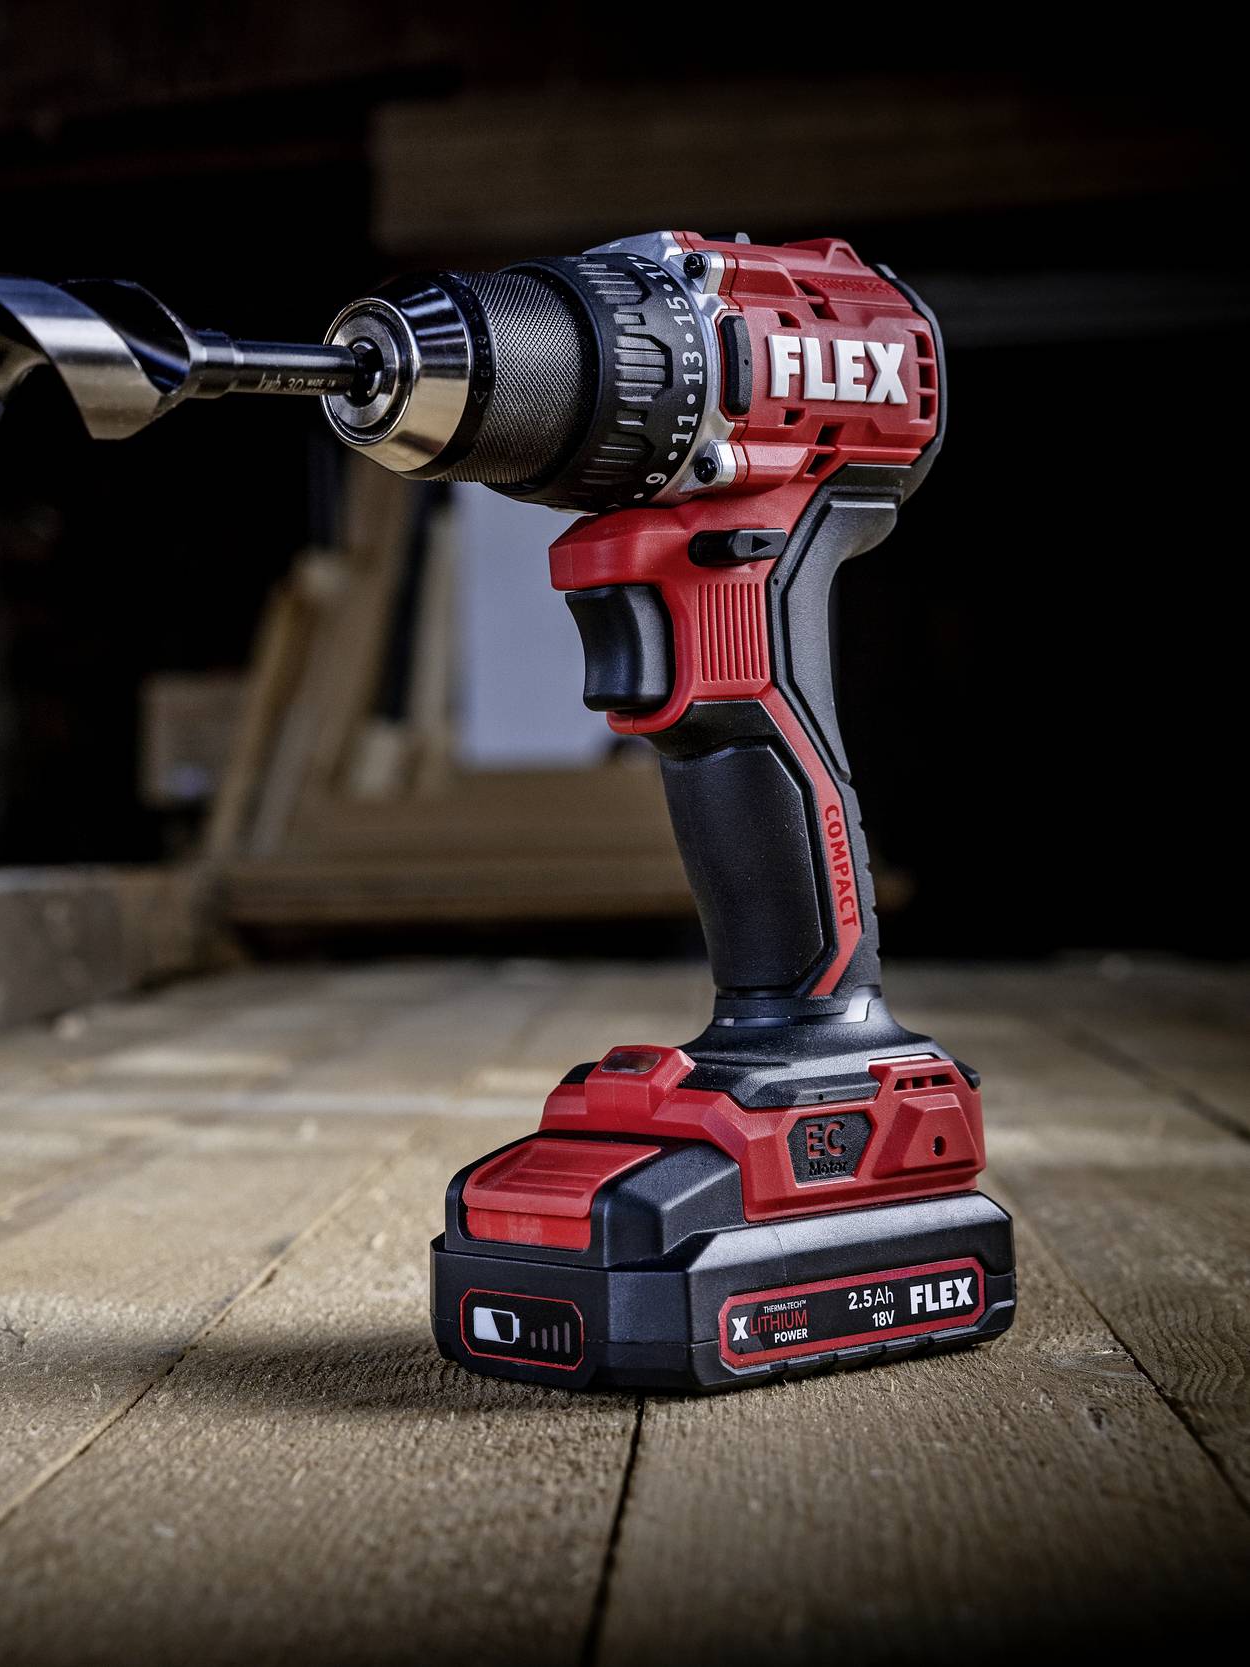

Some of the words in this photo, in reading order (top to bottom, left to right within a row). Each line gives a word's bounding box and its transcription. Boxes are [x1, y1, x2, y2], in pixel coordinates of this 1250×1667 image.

[665, 296, 696, 326] 15
[682, 351, 703, 385] 13
[766, 334, 908, 405] FLEX
[671, 412, 699, 445] 11
[825, 804, 857, 927] COMPACT
[805, 1120, 846, 1160] EC
[809, 1160, 848, 1176] Motor
[909, 1276, 974, 1316] FLEX
[731, 1316, 749, 1342] X
[750, 1309, 808, 1336] LITHIUM
[774, 1327, 809, 1344] POWER
[872, 1310, 895, 1329] 18V
